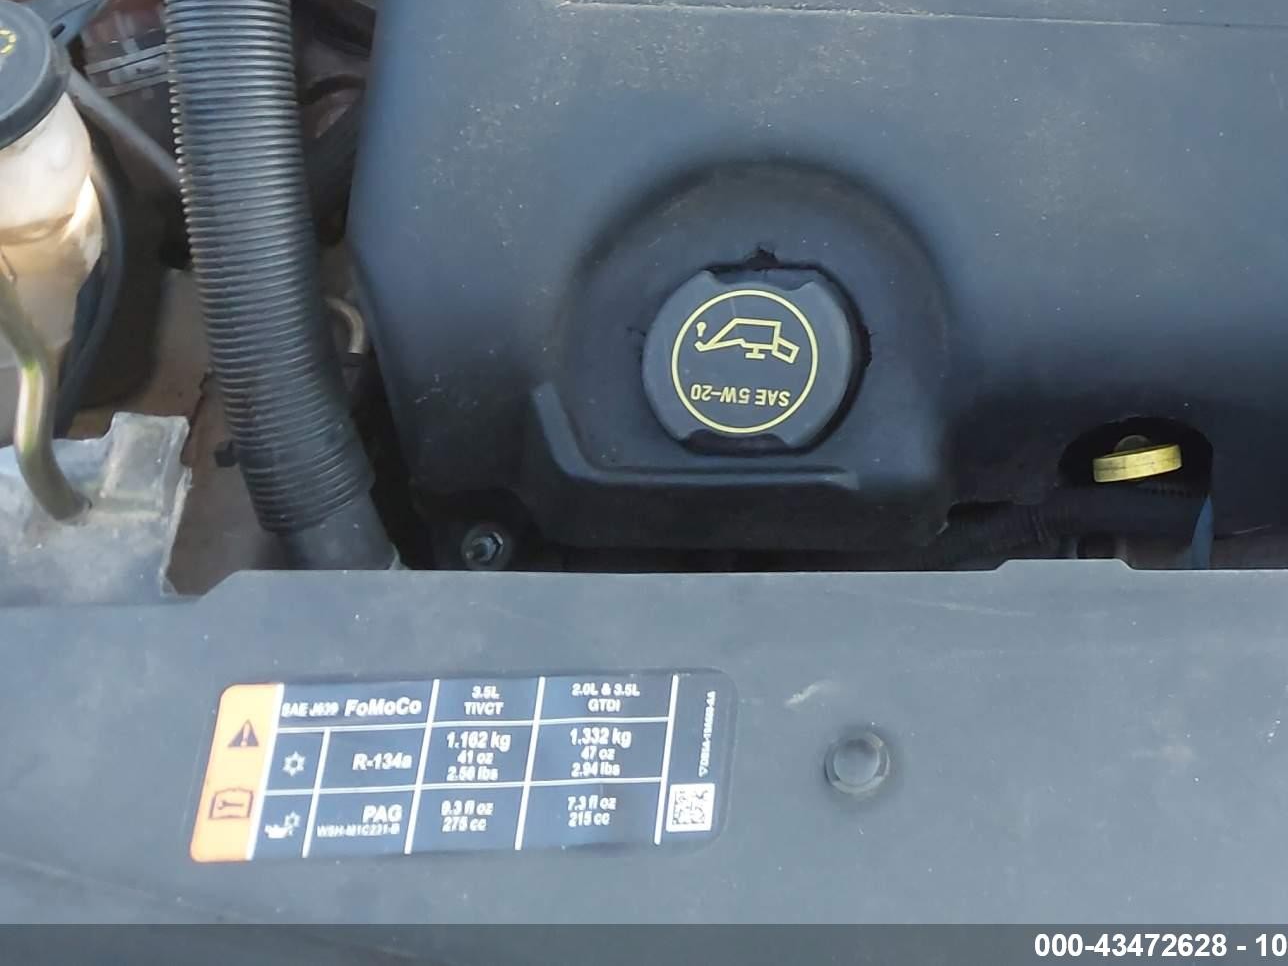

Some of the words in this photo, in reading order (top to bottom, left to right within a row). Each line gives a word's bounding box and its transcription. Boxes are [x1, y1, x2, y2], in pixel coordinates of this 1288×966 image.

[690, 384, 750, 404] 5W-20
[755, 388, 791, 407] SAE
[471, 685, 500, 699] 3.5L
[571, 683, 598, 696] 2.0L
[601, 683, 611, 696] &
[613, 683, 641, 697] 3.5L
[281, 702, 308, 717] SAE
[344, 696, 422, 717] FoMoCo
[446, 731, 489, 749] 1.162
[490, 731, 511, 752] kg
[569, 727, 609, 745] 1.332
[612, 728, 632, 748] kg
[352, 752, 412, 770] R-134a
[457, 750, 474, 765] 41
[476, 752, 494, 765] oz
[581, 745, 597, 760] 47
[599, 748, 616, 761] oz
[477, 766, 499, 781] lbs
[571, 762, 598, 777] 2.94
[600, 762, 620, 776] lbs
[476, 802, 494, 816] oz
[567, 796, 586, 811] 7.3
[601, 797, 617, 810] oz
[362, 804, 402, 823] PAG
[568, 813, 592, 828] 215
[593, 812, 610, 826] cc
[469, 818, 487, 832] cc
